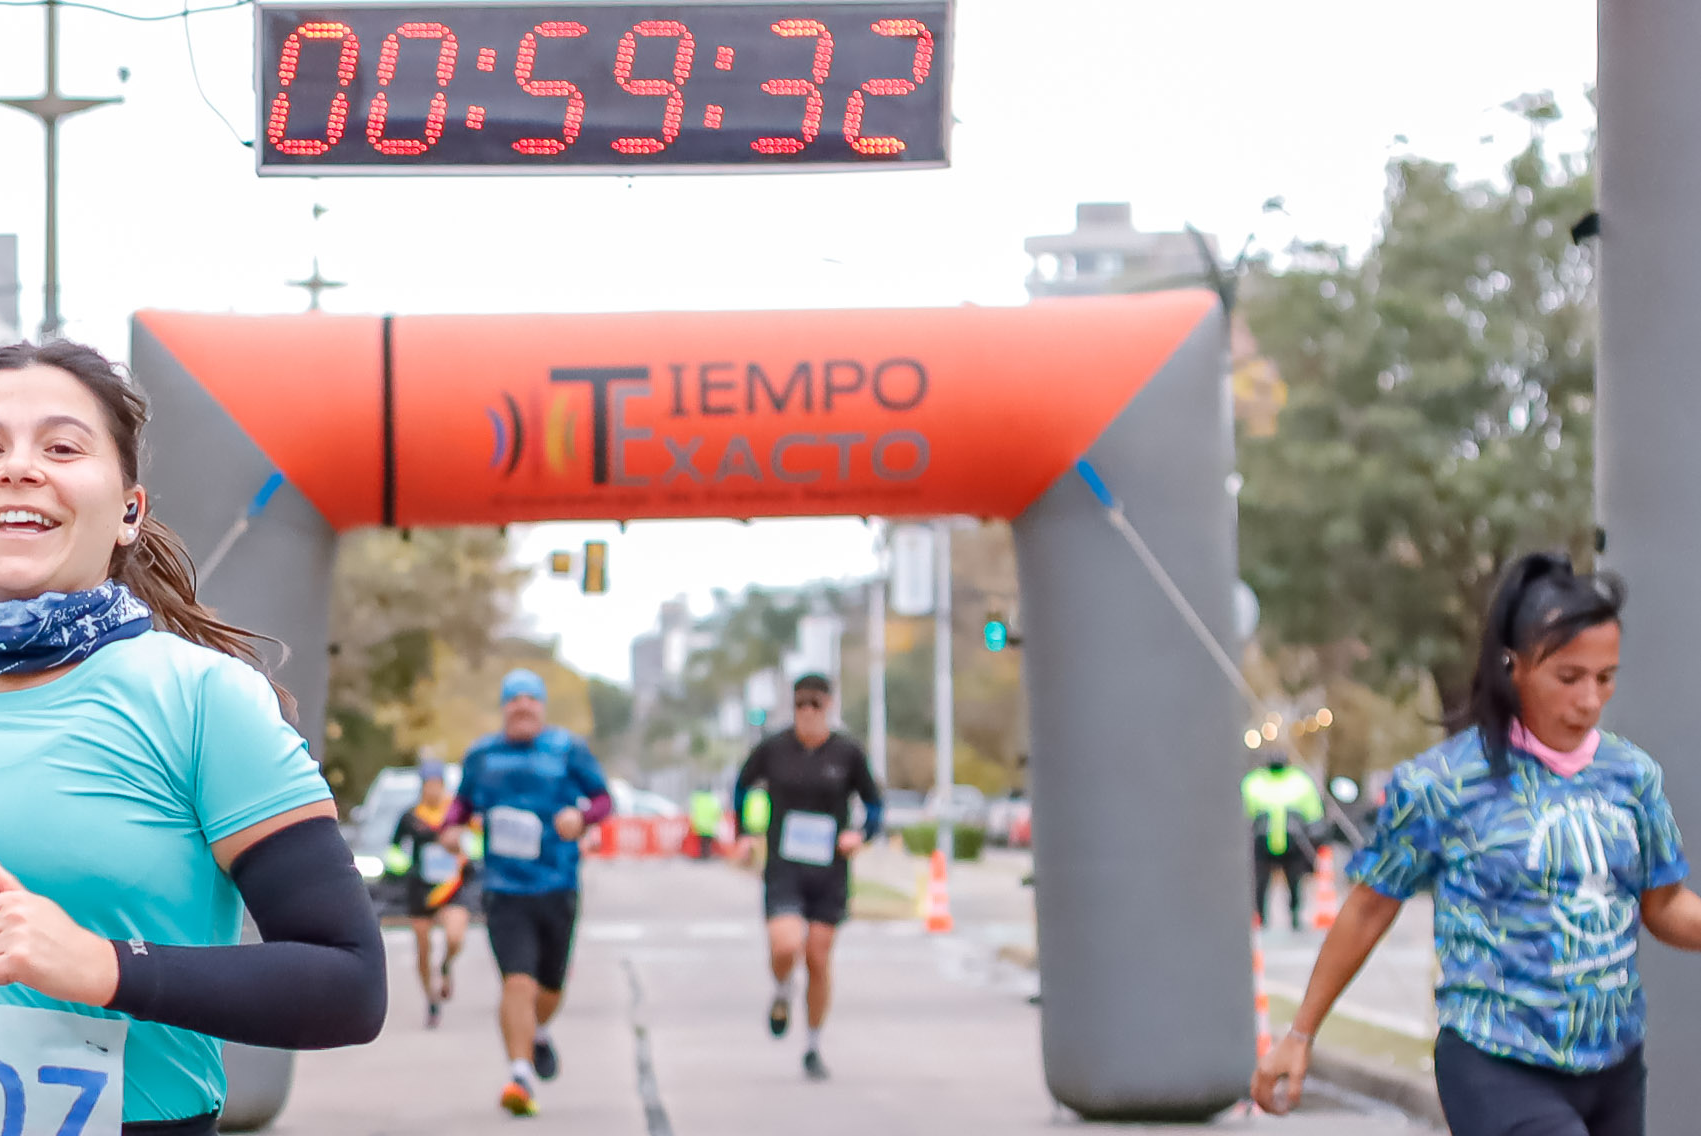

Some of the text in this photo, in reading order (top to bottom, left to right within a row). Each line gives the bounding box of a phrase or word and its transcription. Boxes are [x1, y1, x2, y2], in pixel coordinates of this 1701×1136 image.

[267, 20, 934, 156] 00:59:32
[550, 357, 929, 485] TIEMPO
[612, 388, 931, 487] EXACTO
